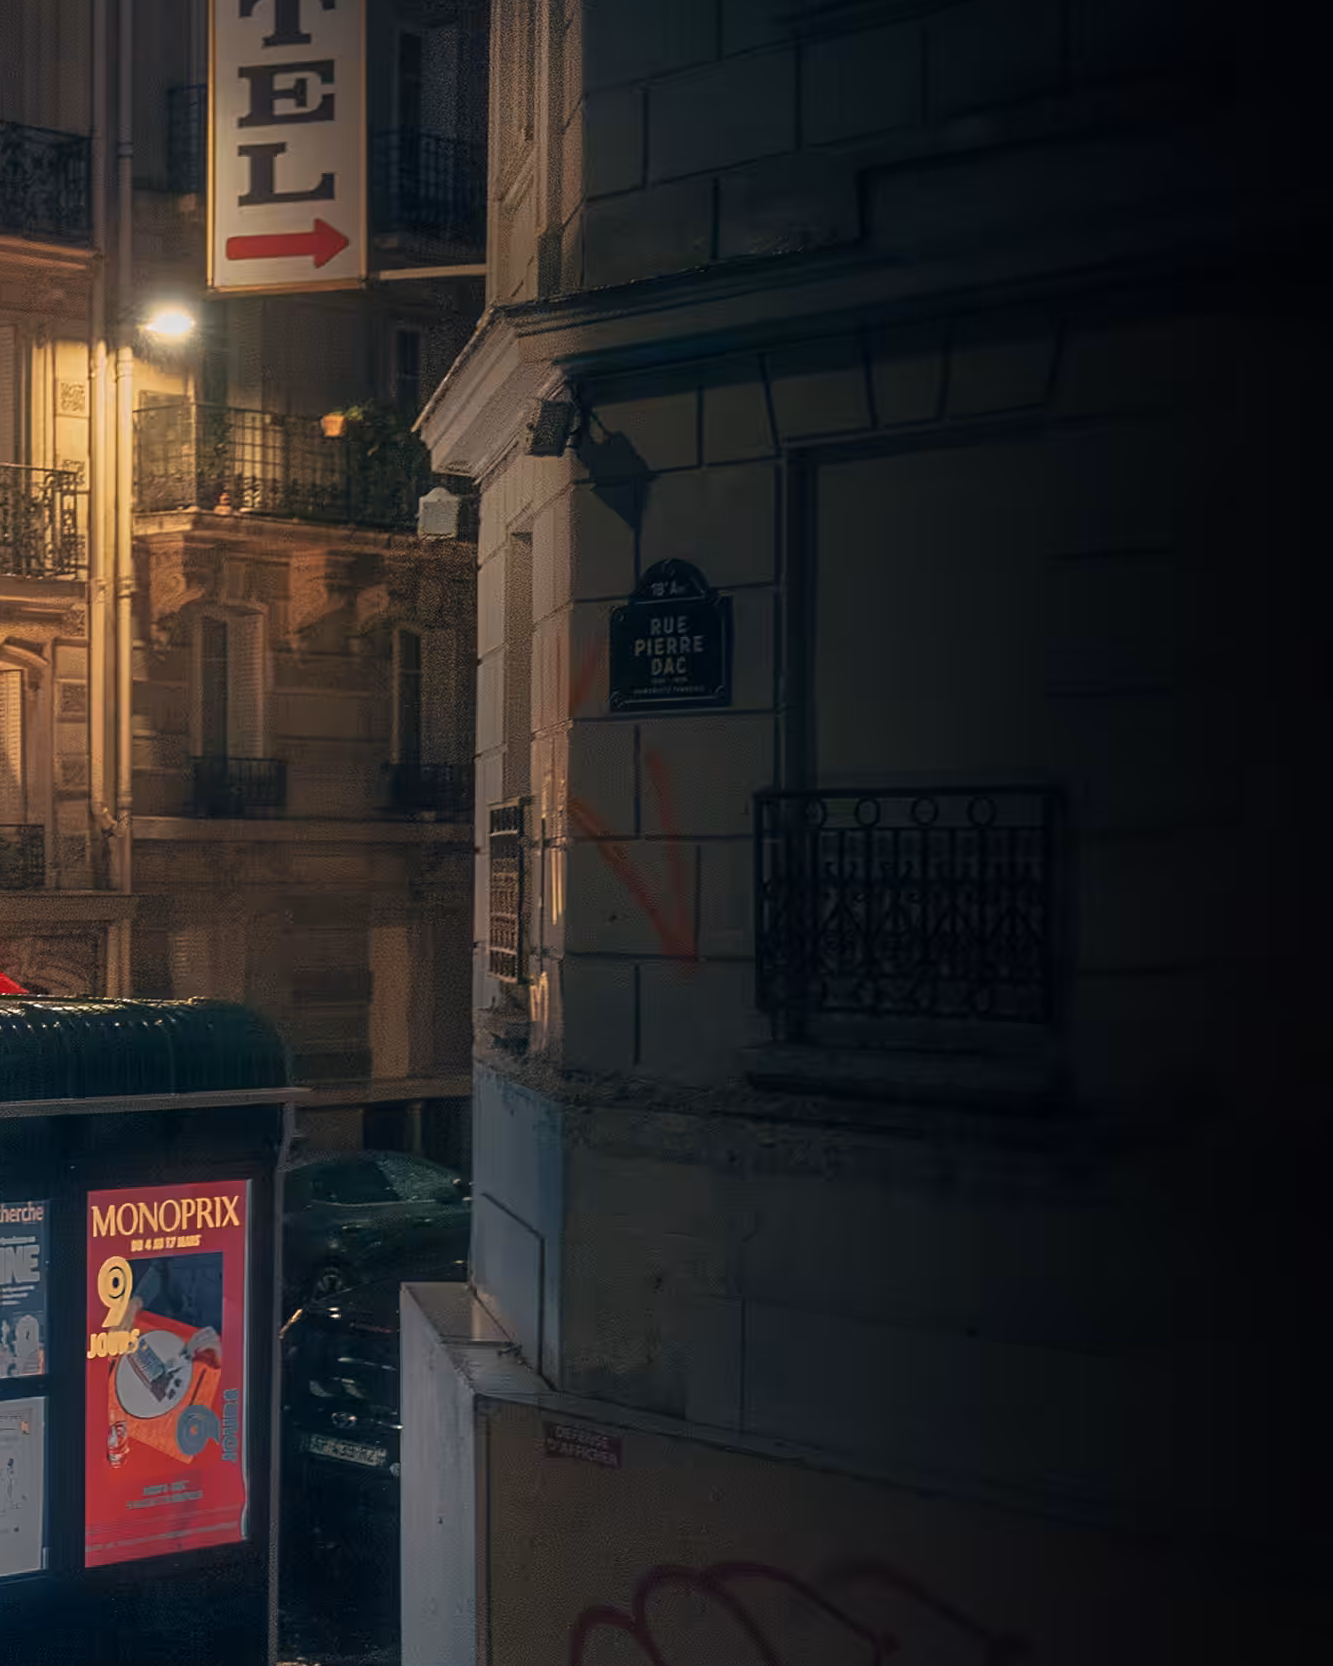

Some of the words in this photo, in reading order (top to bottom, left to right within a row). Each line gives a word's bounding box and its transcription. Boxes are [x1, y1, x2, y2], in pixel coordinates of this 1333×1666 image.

[649, 615, 689, 636] RUE
[634, 635, 706, 657] PIERRE
[650, 656, 687, 676] DAC
[91, 1195, 241, 1237] MONOPRIX
[97, 1255, 133, 1328] 9
